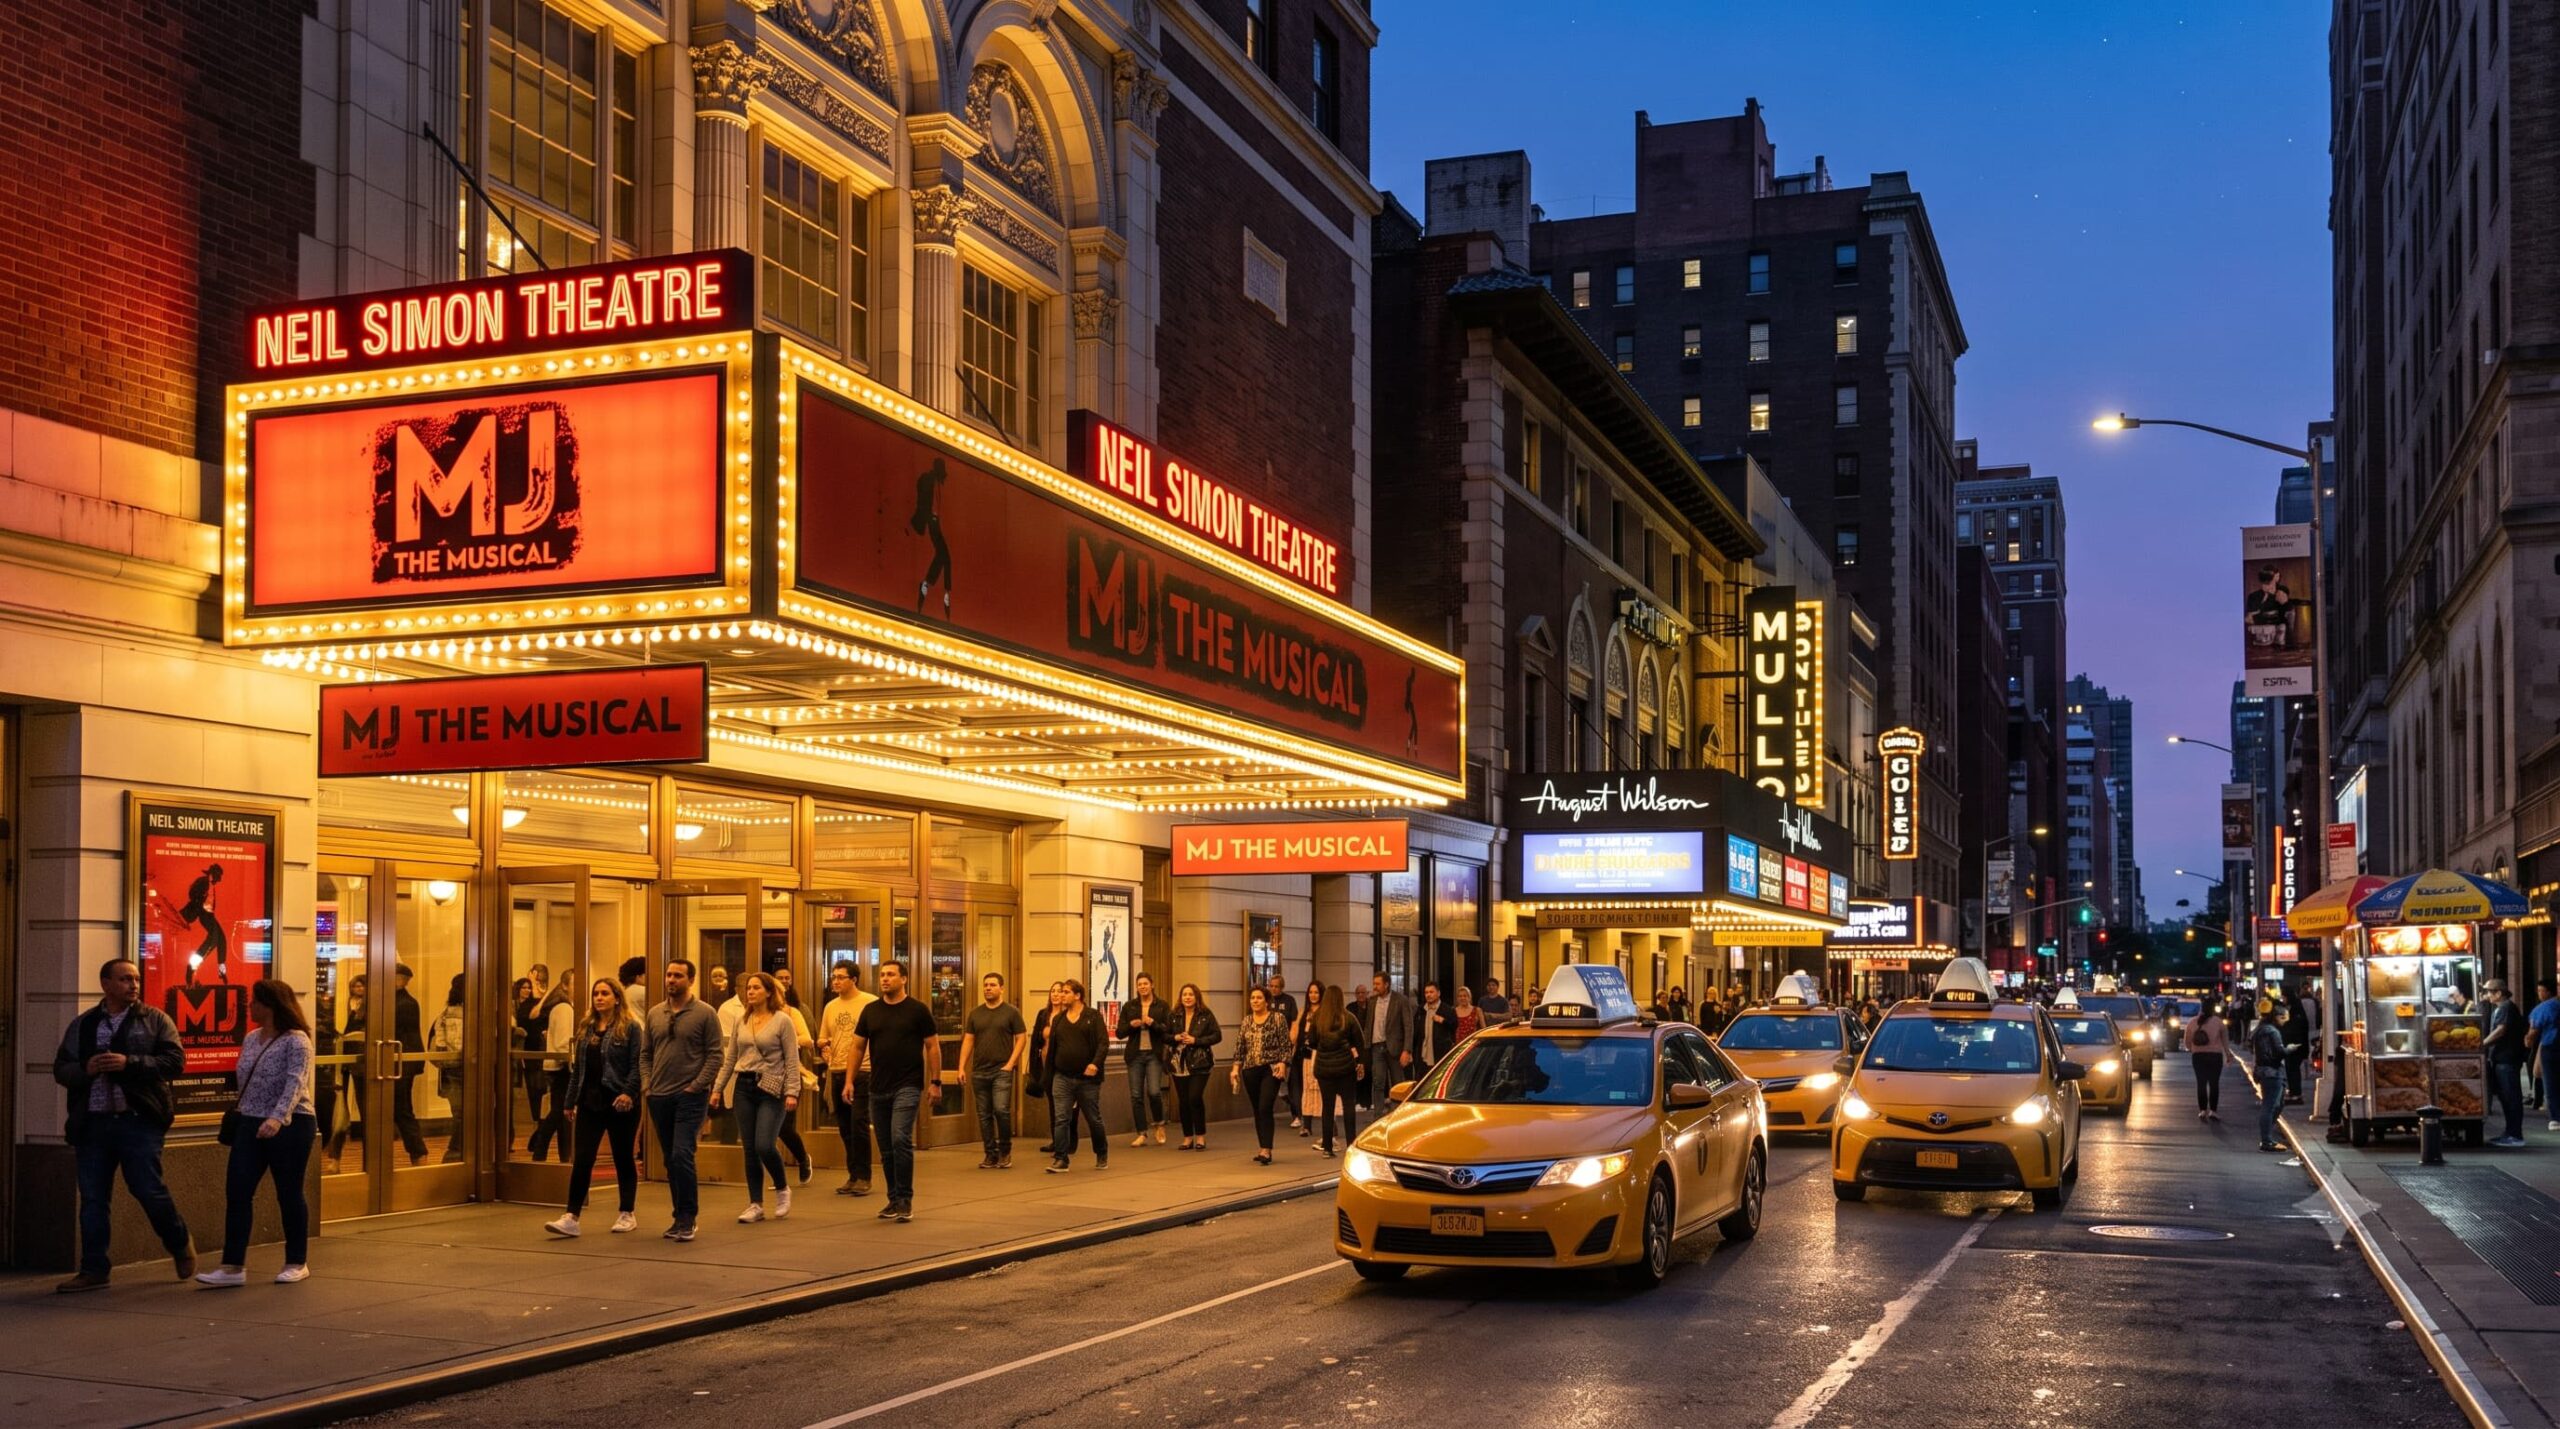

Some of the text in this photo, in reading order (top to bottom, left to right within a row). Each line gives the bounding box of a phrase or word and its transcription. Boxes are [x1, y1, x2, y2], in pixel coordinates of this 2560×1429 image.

[256, 263, 722, 368] NEIL SIMON THEATRE
[395, 410, 555, 543] MJ
[1099, 424, 1337, 594] NEIL SIMON THEATRE
[394, 541, 557, 576] THE MUSICAL
[1078, 536, 1150, 657] MJ
[1169, 592, 1362, 718] THE MUSICAL
[343, 696, 682, 750] MJ THE MUSICAL
[149, 813, 264, 836] NEIL SIMON THEATRE
[1520, 776, 1709, 822] August Wilson
[1186, 836, 1392, 861] MJ THE MUSICAL
[177, 989, 237, 1032] MJ
